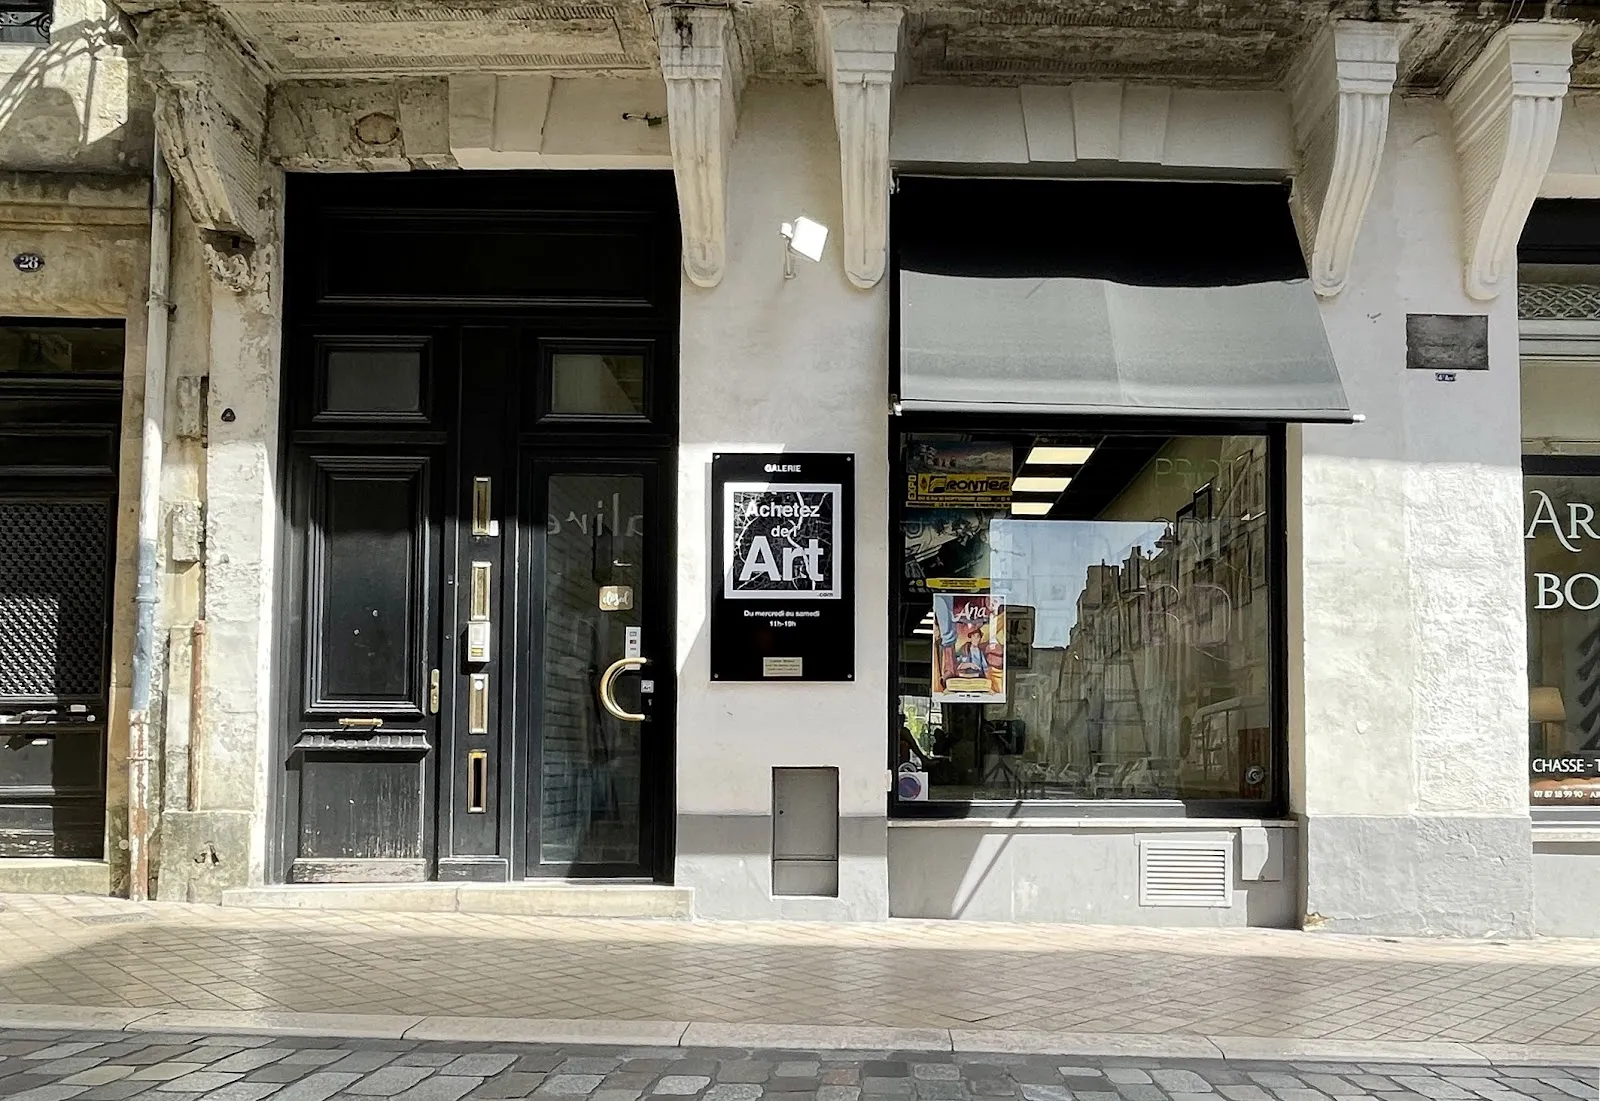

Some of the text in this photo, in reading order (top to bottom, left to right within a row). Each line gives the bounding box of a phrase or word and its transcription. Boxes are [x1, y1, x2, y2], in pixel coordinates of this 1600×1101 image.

[19, 255, 39, 269] 28
[764, 464, 802, 473] GALERIE
[745, 499, 821, 518] Achetez
[770, 525, 788, 538] de
[738, 535, 824, 582] Art
[952, 601, 987, 620] Ana
[1532, 758, 1585, 773] CHASSE
[1534, 790, 1543, 798] 07
[1563, 790, 1572, 798] 99
[1573, 790, 1583, 798] 90
